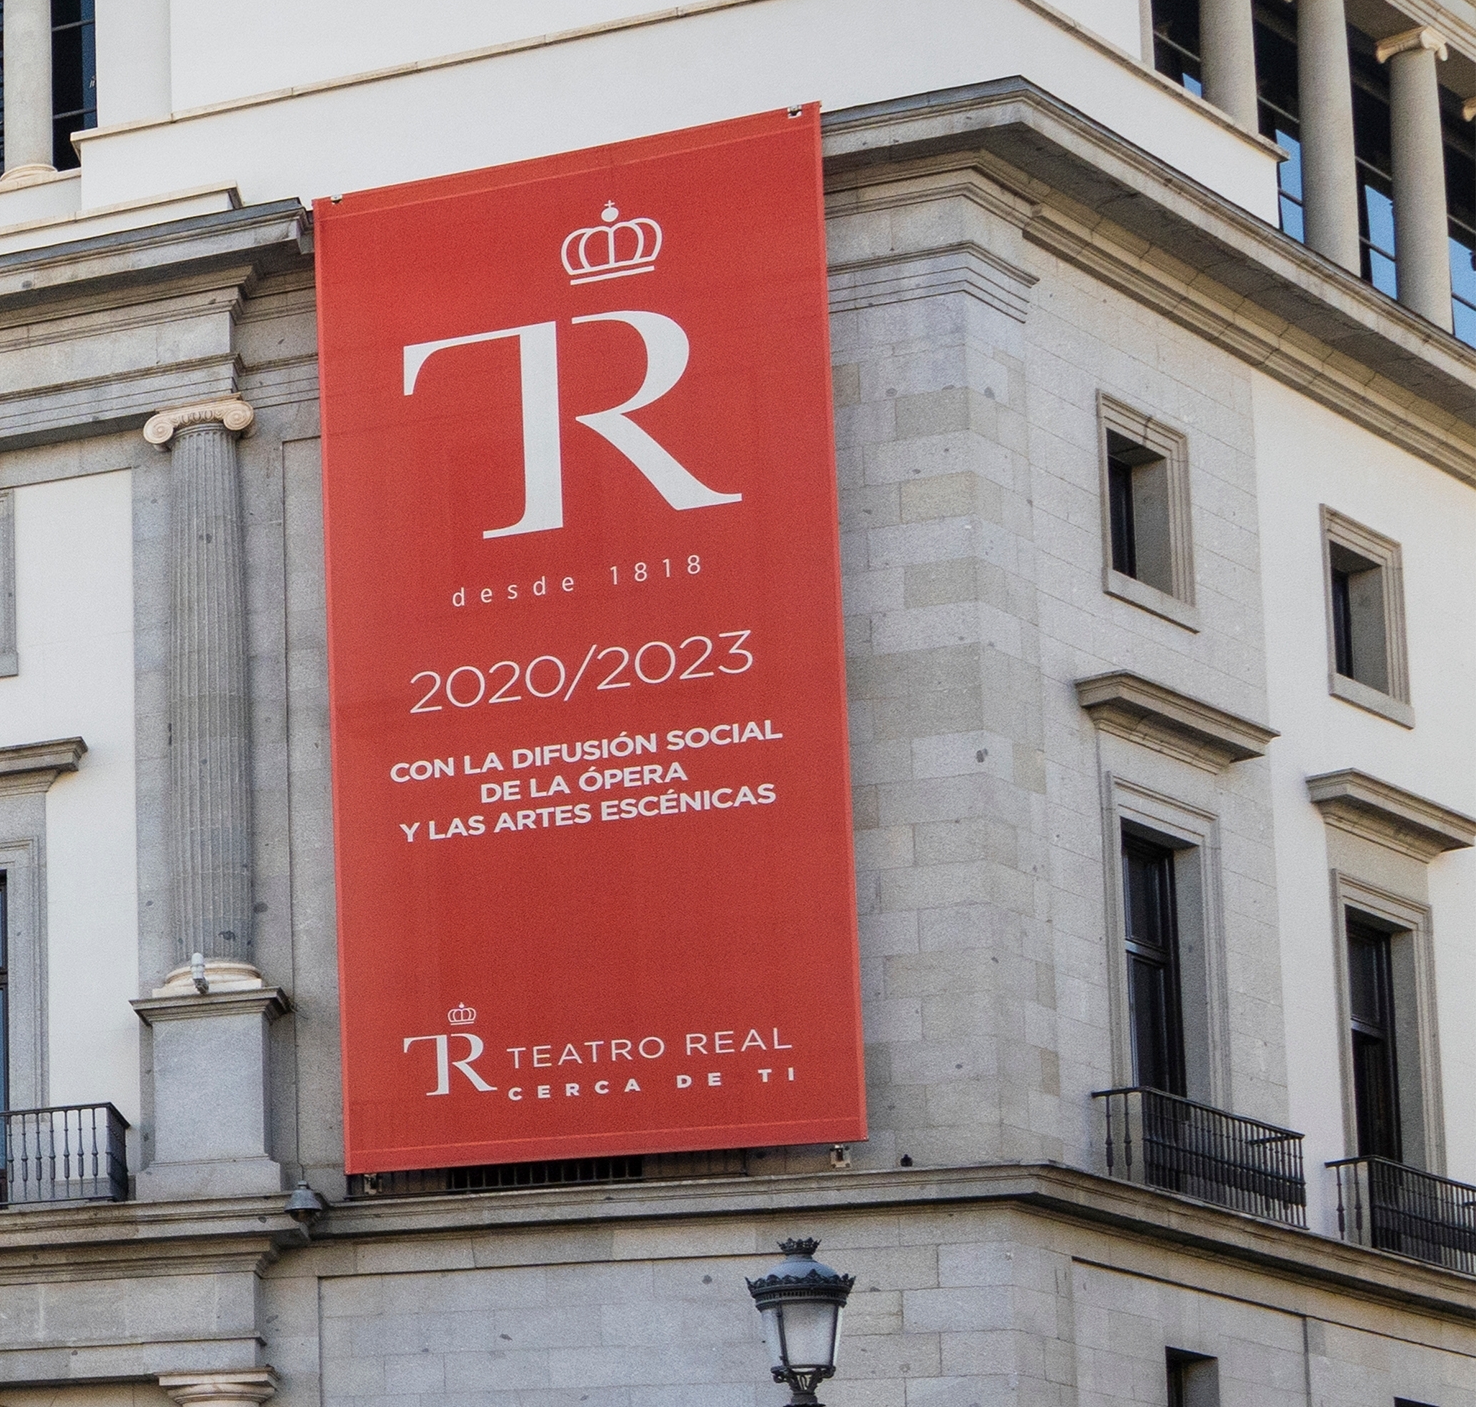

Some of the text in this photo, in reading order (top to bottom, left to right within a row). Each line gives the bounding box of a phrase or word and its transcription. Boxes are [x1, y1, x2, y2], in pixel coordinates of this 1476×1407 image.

[403, 310, 742, 539] TR
[452, 555, 701, 607] desde 1818
[409, 629, 754, 714] 2020/2023
[390, 720, 783, 783] CON LA DIFUSIÓN SOCIAL
[480, 761, 688, 803] DE LA ÓPERA
[400, 784, 777, 842] Y LAS ARTES ESCÉNICAS
[403, 1033, 498, 1096] TR
[507, 1027, 792, 1069] TEATRO REAL
[508, 1067, 794, 1101] CERCA DE TI
